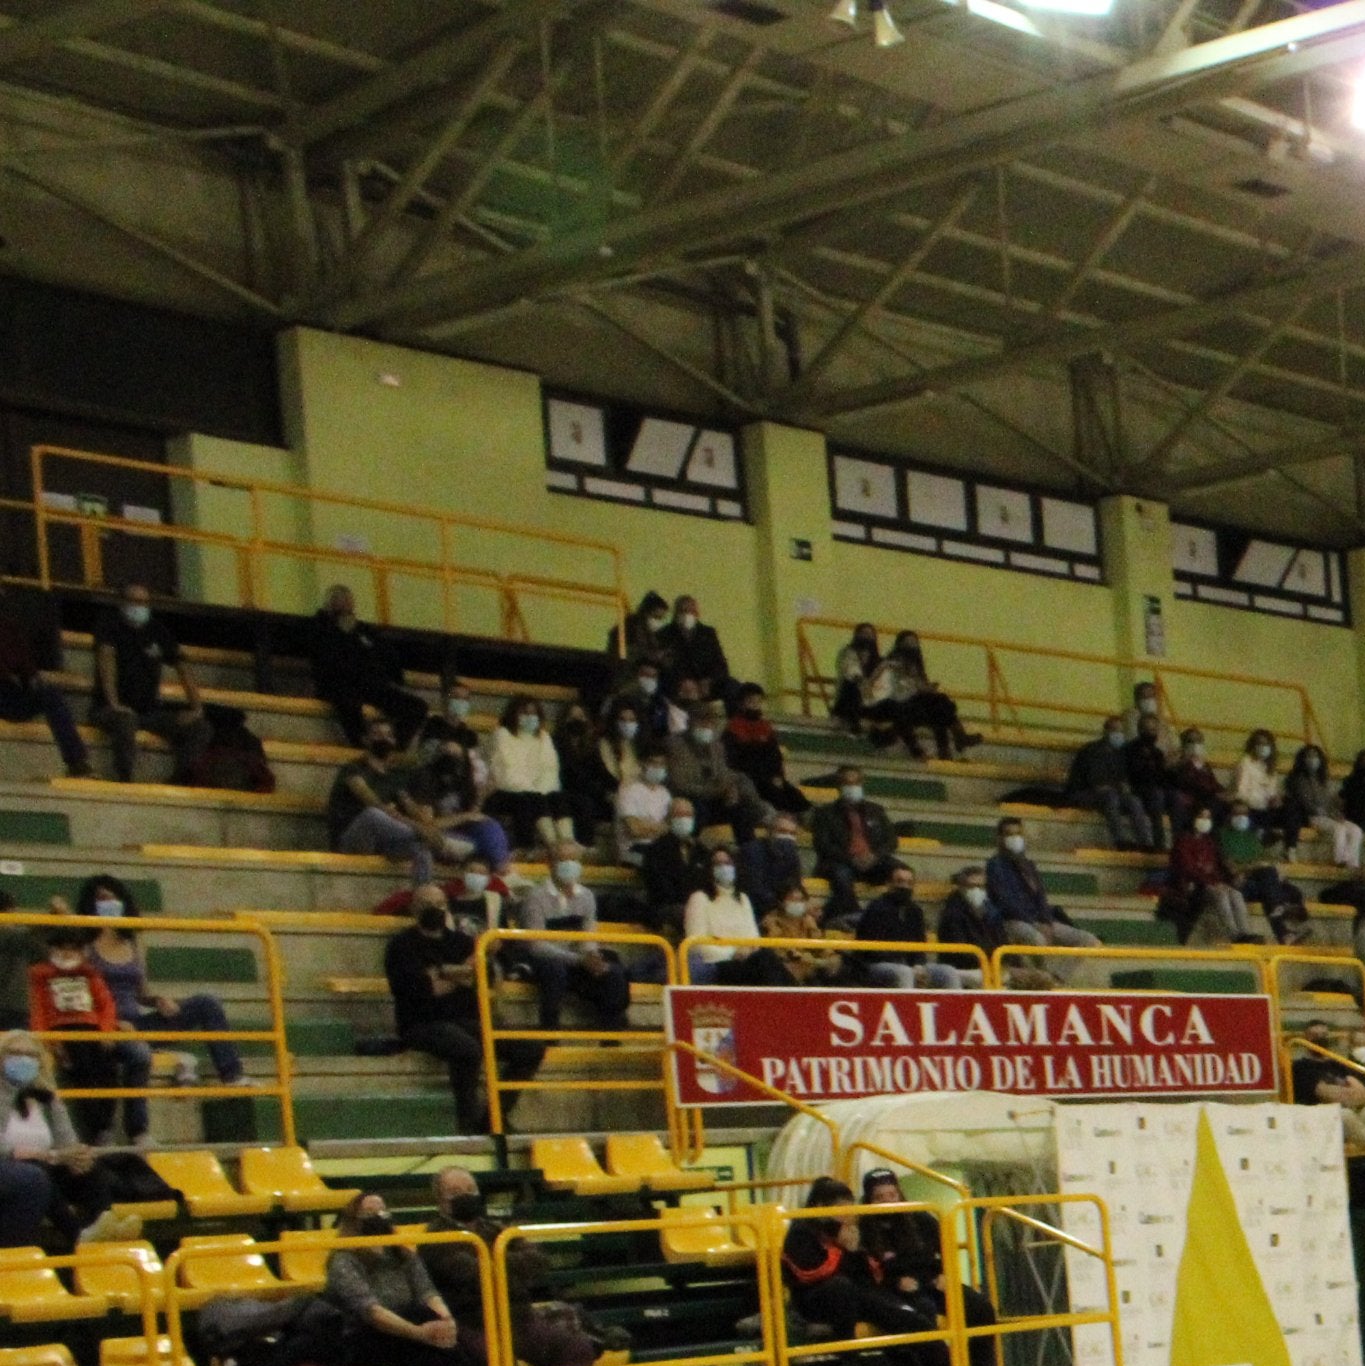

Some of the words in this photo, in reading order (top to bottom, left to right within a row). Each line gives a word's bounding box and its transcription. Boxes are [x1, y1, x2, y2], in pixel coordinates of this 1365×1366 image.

[828, 1000, 1215, 1047] SALAMANCA
[760, 1055, 982, 1094] PATRIMONIO
[990, 1055, 1037, 1090] DE
[1043, 1055, 1083, 1090] LA
[1089, 1052, 1262, 1089] HUMANIDAD
